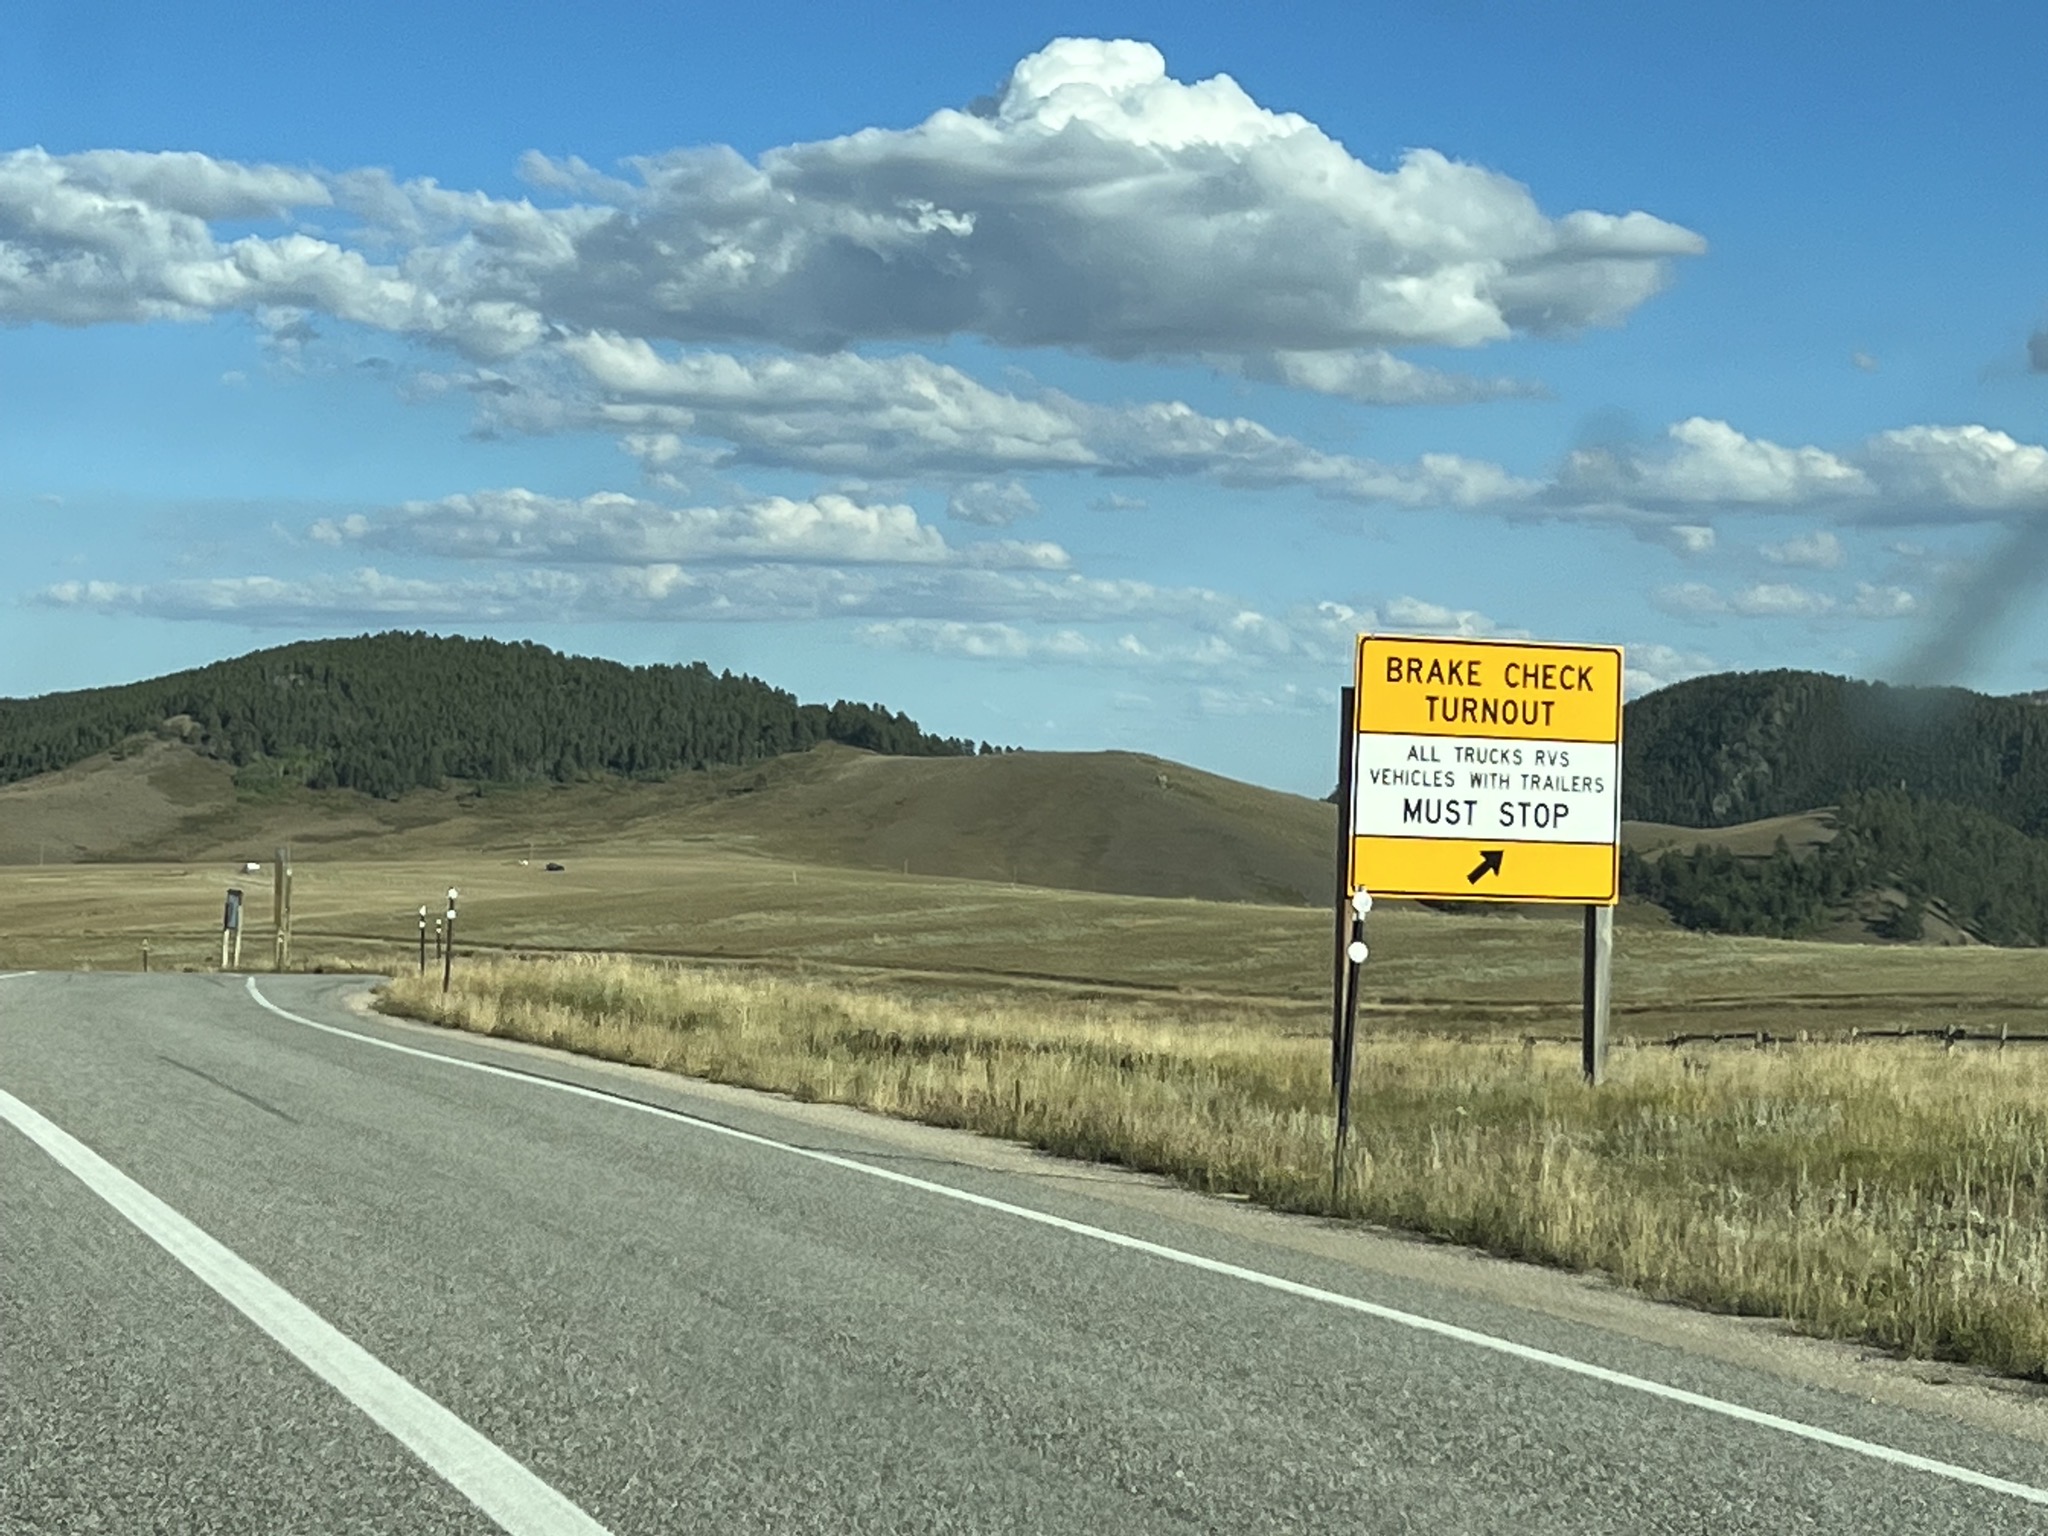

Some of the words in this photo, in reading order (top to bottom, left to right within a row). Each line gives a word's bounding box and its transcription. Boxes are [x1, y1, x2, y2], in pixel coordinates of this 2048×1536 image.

[1386, 657, 1482, 686] BRAKE
[1505, 663, 1593, 691] CHECK
[1425, 696, 1555, 726] TURNOUT
[1407, 745, 1440, 762] ALL
[1455, 747, 1523, 766] TRUCKS
[1535, 749, 1570, 767] RVS
[1370, 769, 1455, 788] VEHICLES
[1470, 773, 1510, 790] WITH
[1522, 774, 1604, 793] TRAILERS
[1403, 798, 1477, 825] MUST
[1499, 802, 1569, 828] STOP
